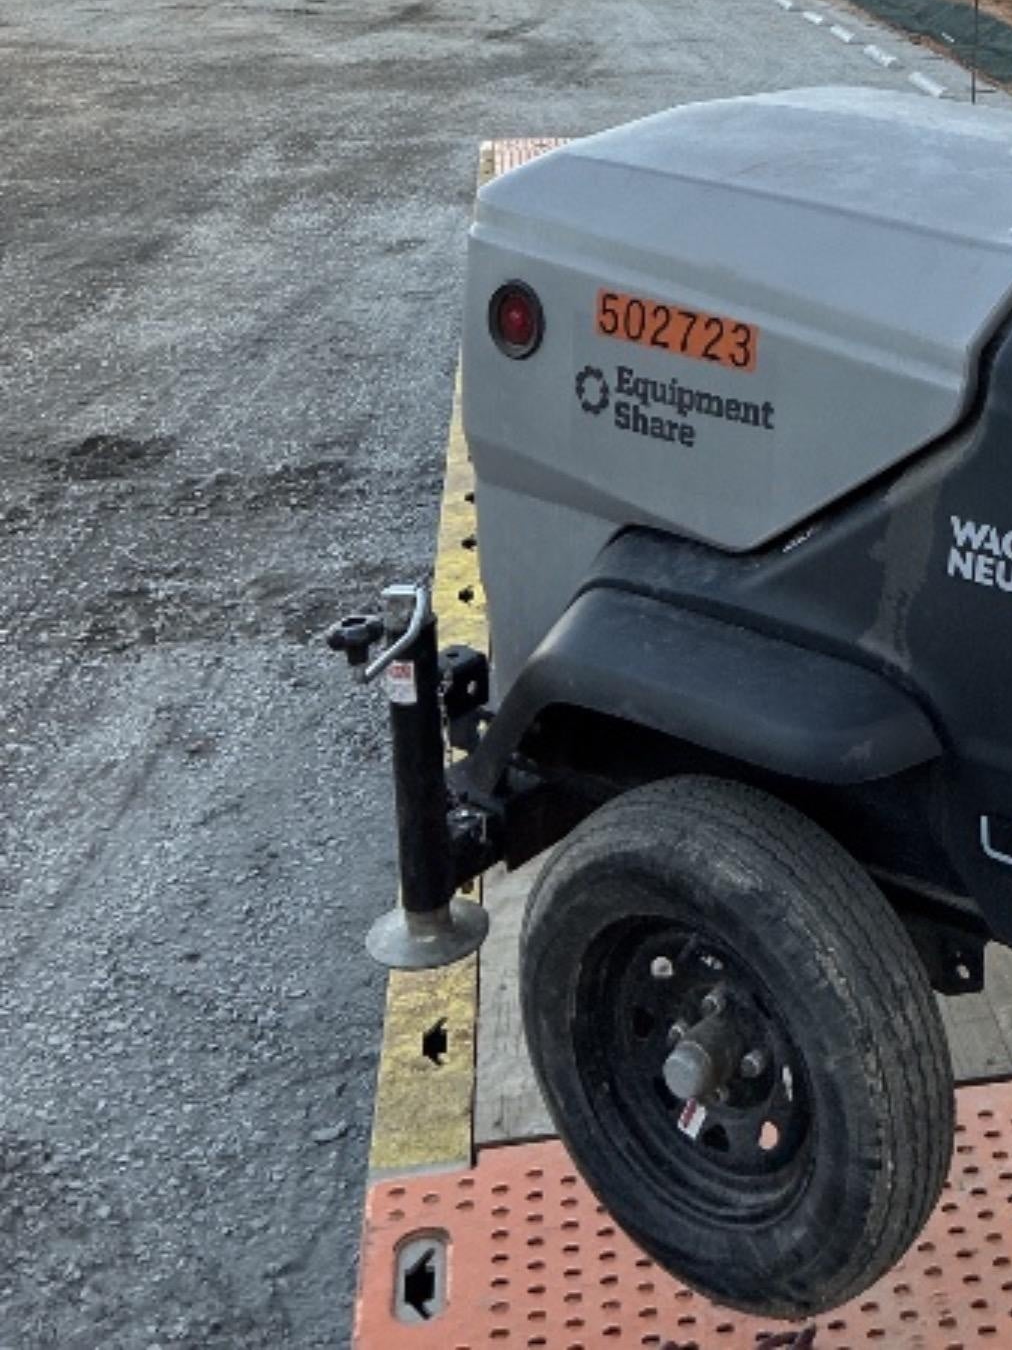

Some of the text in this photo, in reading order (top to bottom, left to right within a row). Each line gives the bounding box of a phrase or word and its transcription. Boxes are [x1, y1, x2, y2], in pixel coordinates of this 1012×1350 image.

[599, 293, 752, 367] 502723
[614, 401, 696, 447] Share
[615, 365, 775, 429] Equipment
